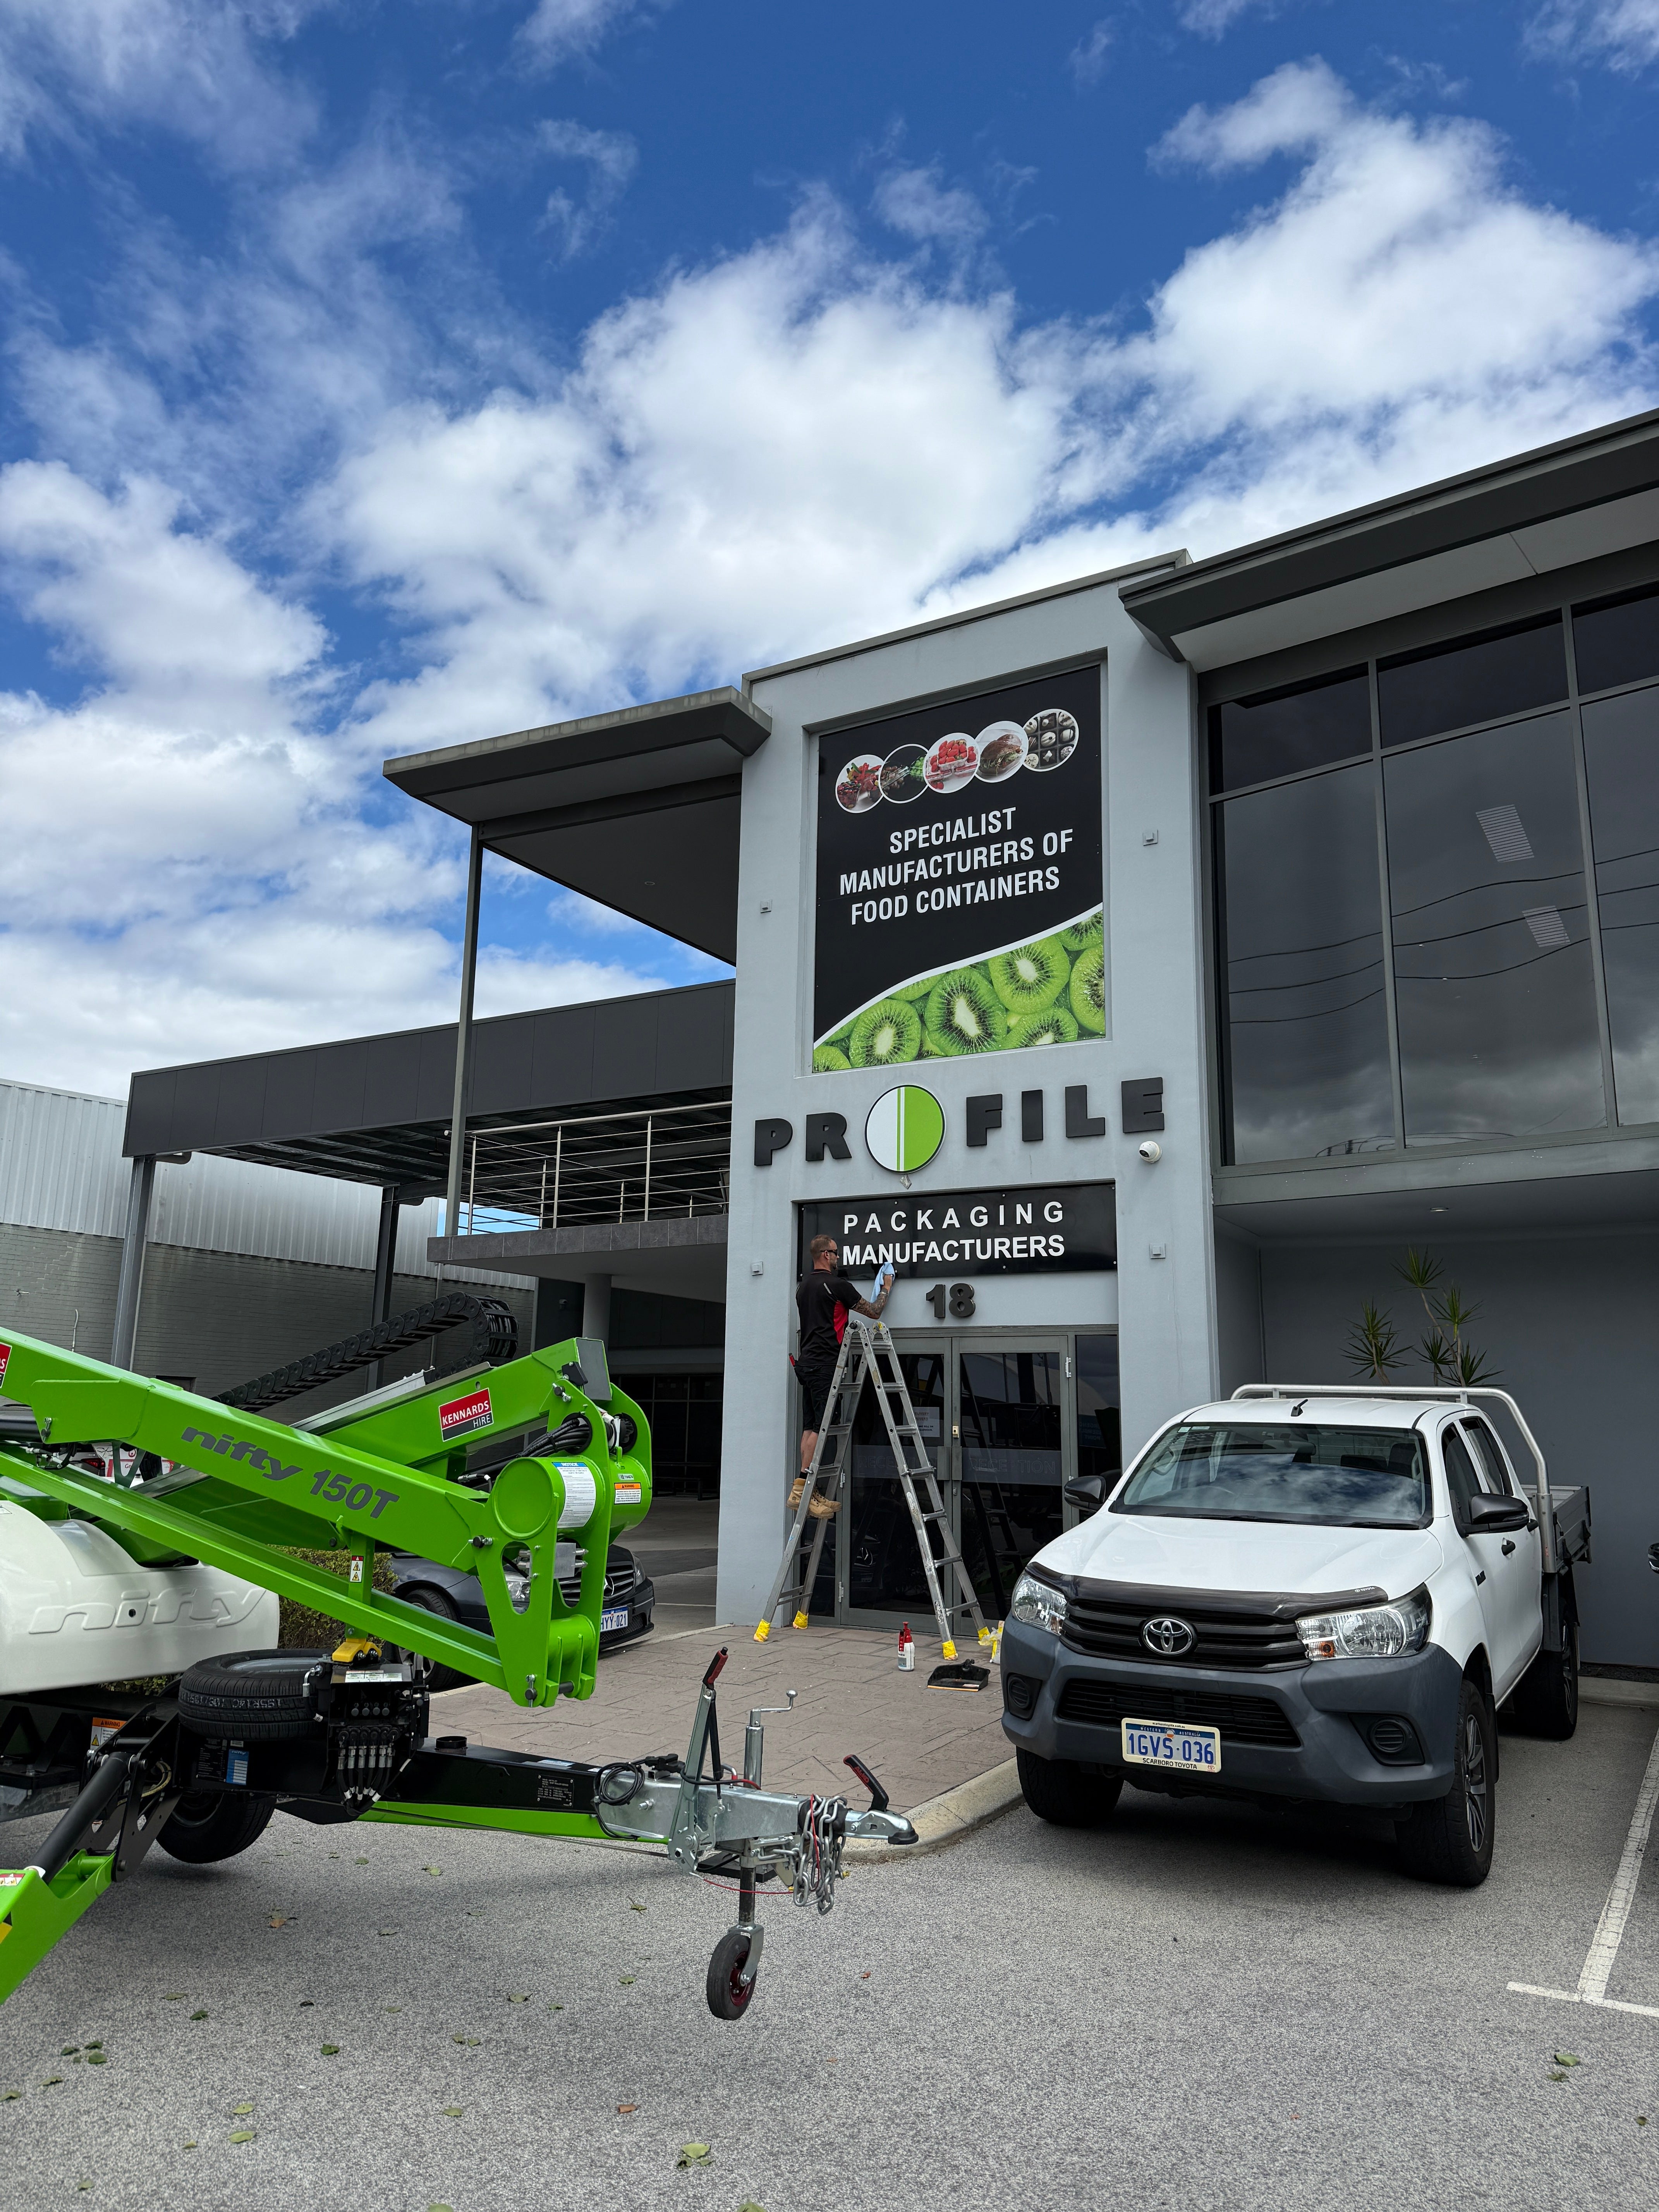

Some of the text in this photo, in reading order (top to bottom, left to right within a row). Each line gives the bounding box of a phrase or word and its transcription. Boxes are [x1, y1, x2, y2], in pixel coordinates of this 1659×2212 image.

[890, 807, 1016, 853] SPECIALIST
[840, 829, 1072, 895] MANUFACTURERS OF
[852, 867, 1059, 925] FOOD CONTAINERS
[845, 1202, 1062, 1234] PACKAGING
[843, 1235, 1064, 1265] MANUFACTURERS
[926, 1283, 975, 1317] 18
[442, 1401, 489, 1425] KENNARDS
[473, 1415, 491, 1428] HIRE
[181, 1427, 400, 1519] nifty 150T
[28, 1587, 266, 1634] nifty
[1143, 1758, 1197, 1769] SCARBORO TOYOTA
